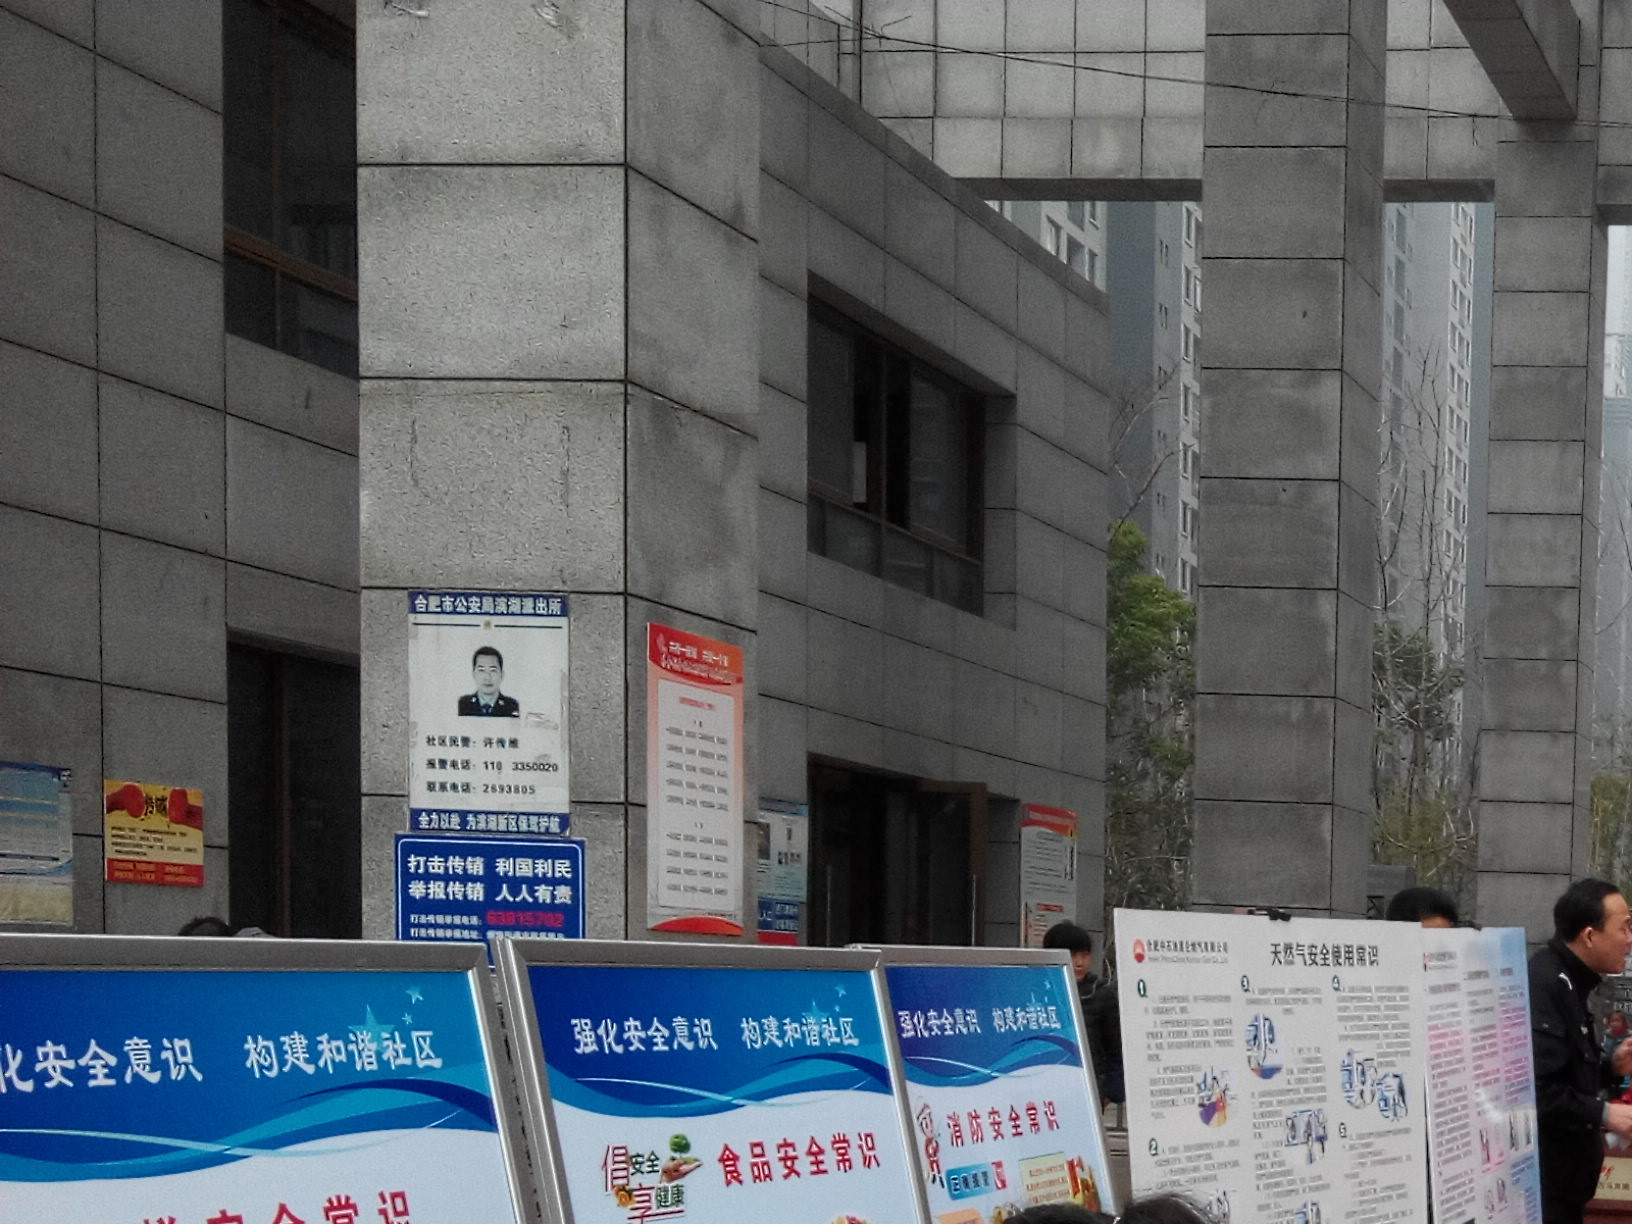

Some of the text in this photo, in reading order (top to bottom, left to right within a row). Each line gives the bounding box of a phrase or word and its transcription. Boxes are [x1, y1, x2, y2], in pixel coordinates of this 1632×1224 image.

[408, 855, 571, 877] 打击传销 利国利民
[409, 880, 572, 904] 举报传销 人人有责
[1271, 942, 1379, 967] 天然气安全使用常识
[571, 1017, 860, 1055] 强化安全意识 构建和谐社区
[898, 1005, 1062, 1039] 强化安全意识 构建和谐社区
[244, 1029, 442, 1079] 构建和谐社区
[947, 1100, 1060, 1147] 消防安全常识
[718, 1131, 880, 1187] 食品安全常识
